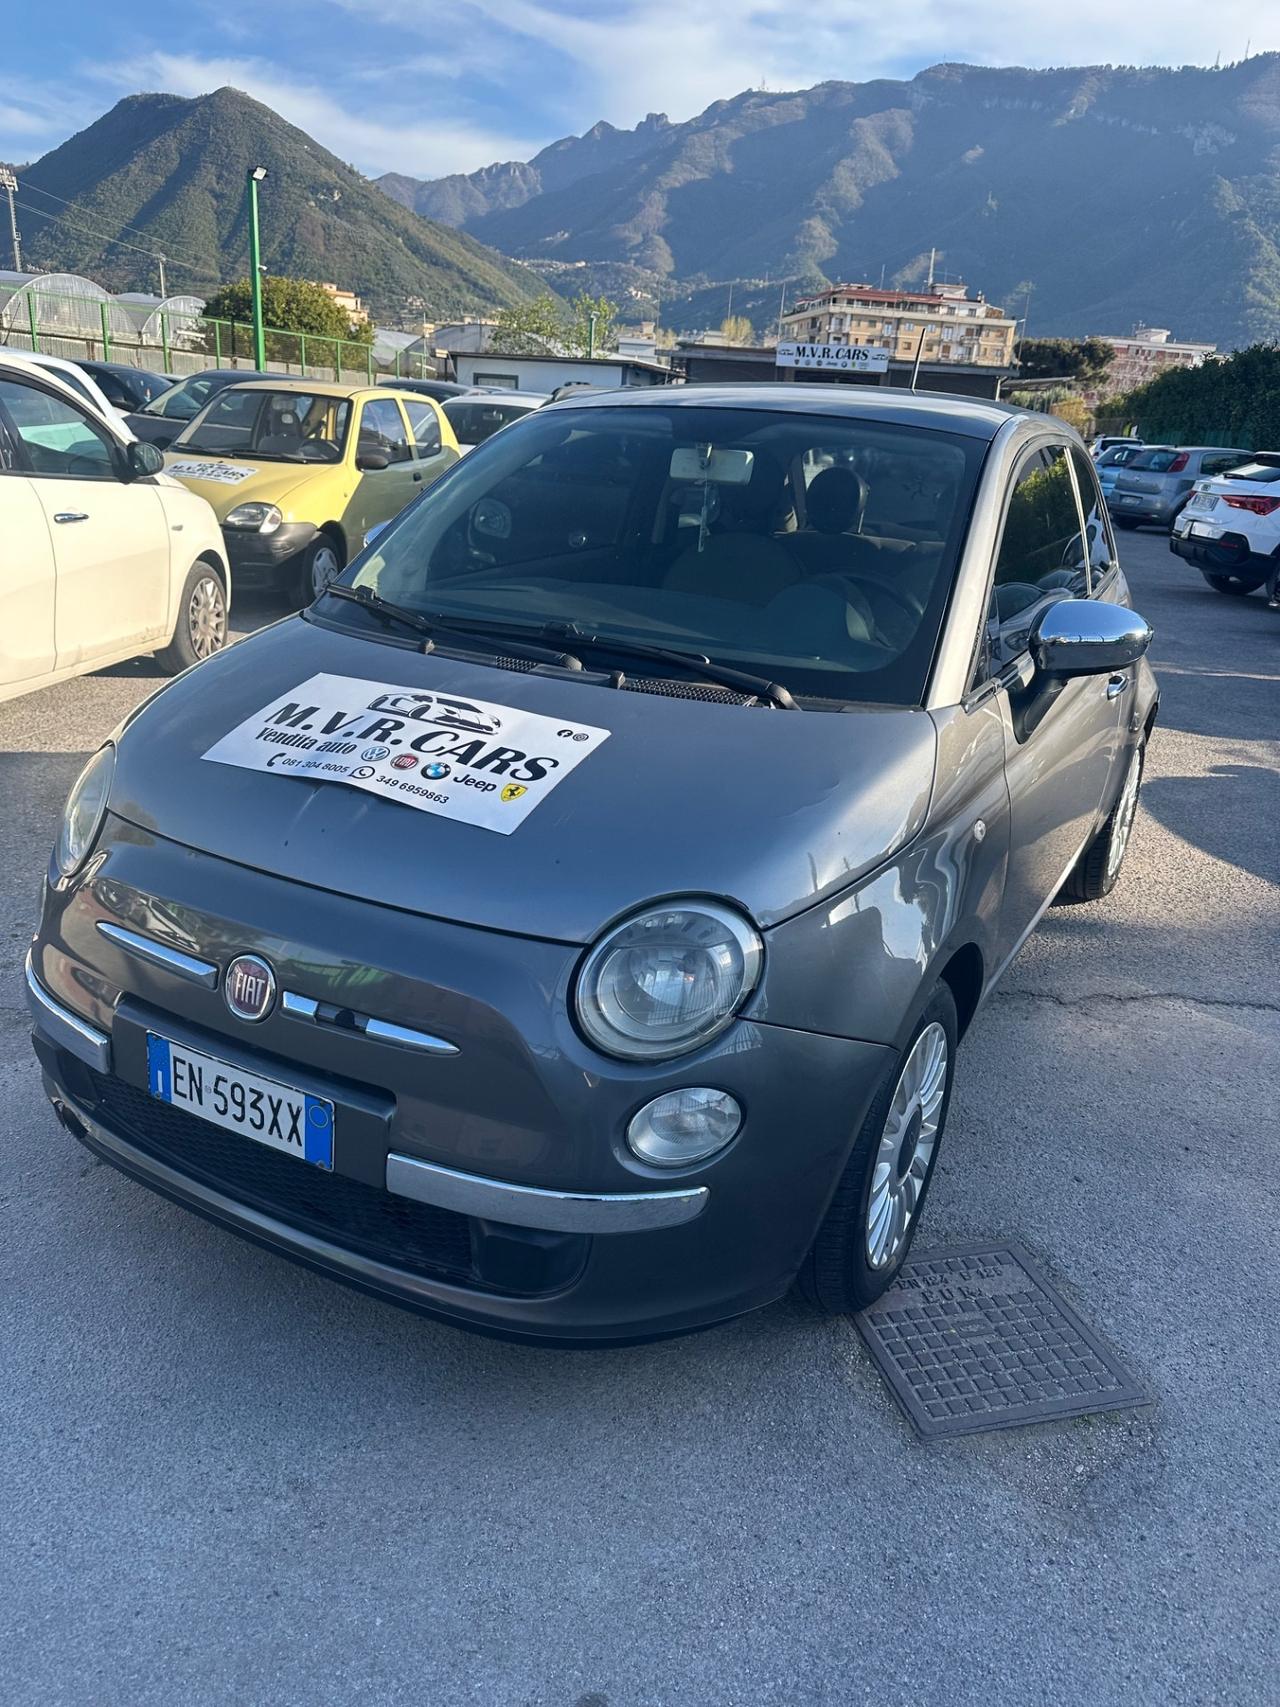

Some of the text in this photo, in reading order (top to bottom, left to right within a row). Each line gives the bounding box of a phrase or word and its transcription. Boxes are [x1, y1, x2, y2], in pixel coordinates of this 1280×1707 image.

[835, 348, 870, 361] CARS
[255, 727, 357, 755] Vendita auto
[282, 758, 350, 773] 081 304 8005
[410, 731, 560, 781] CARS
[376, 775, 450, 804] 349 6959863
[453, 774, 498, 793] Jeep
[235, 972, 265, 1005] FIAT
